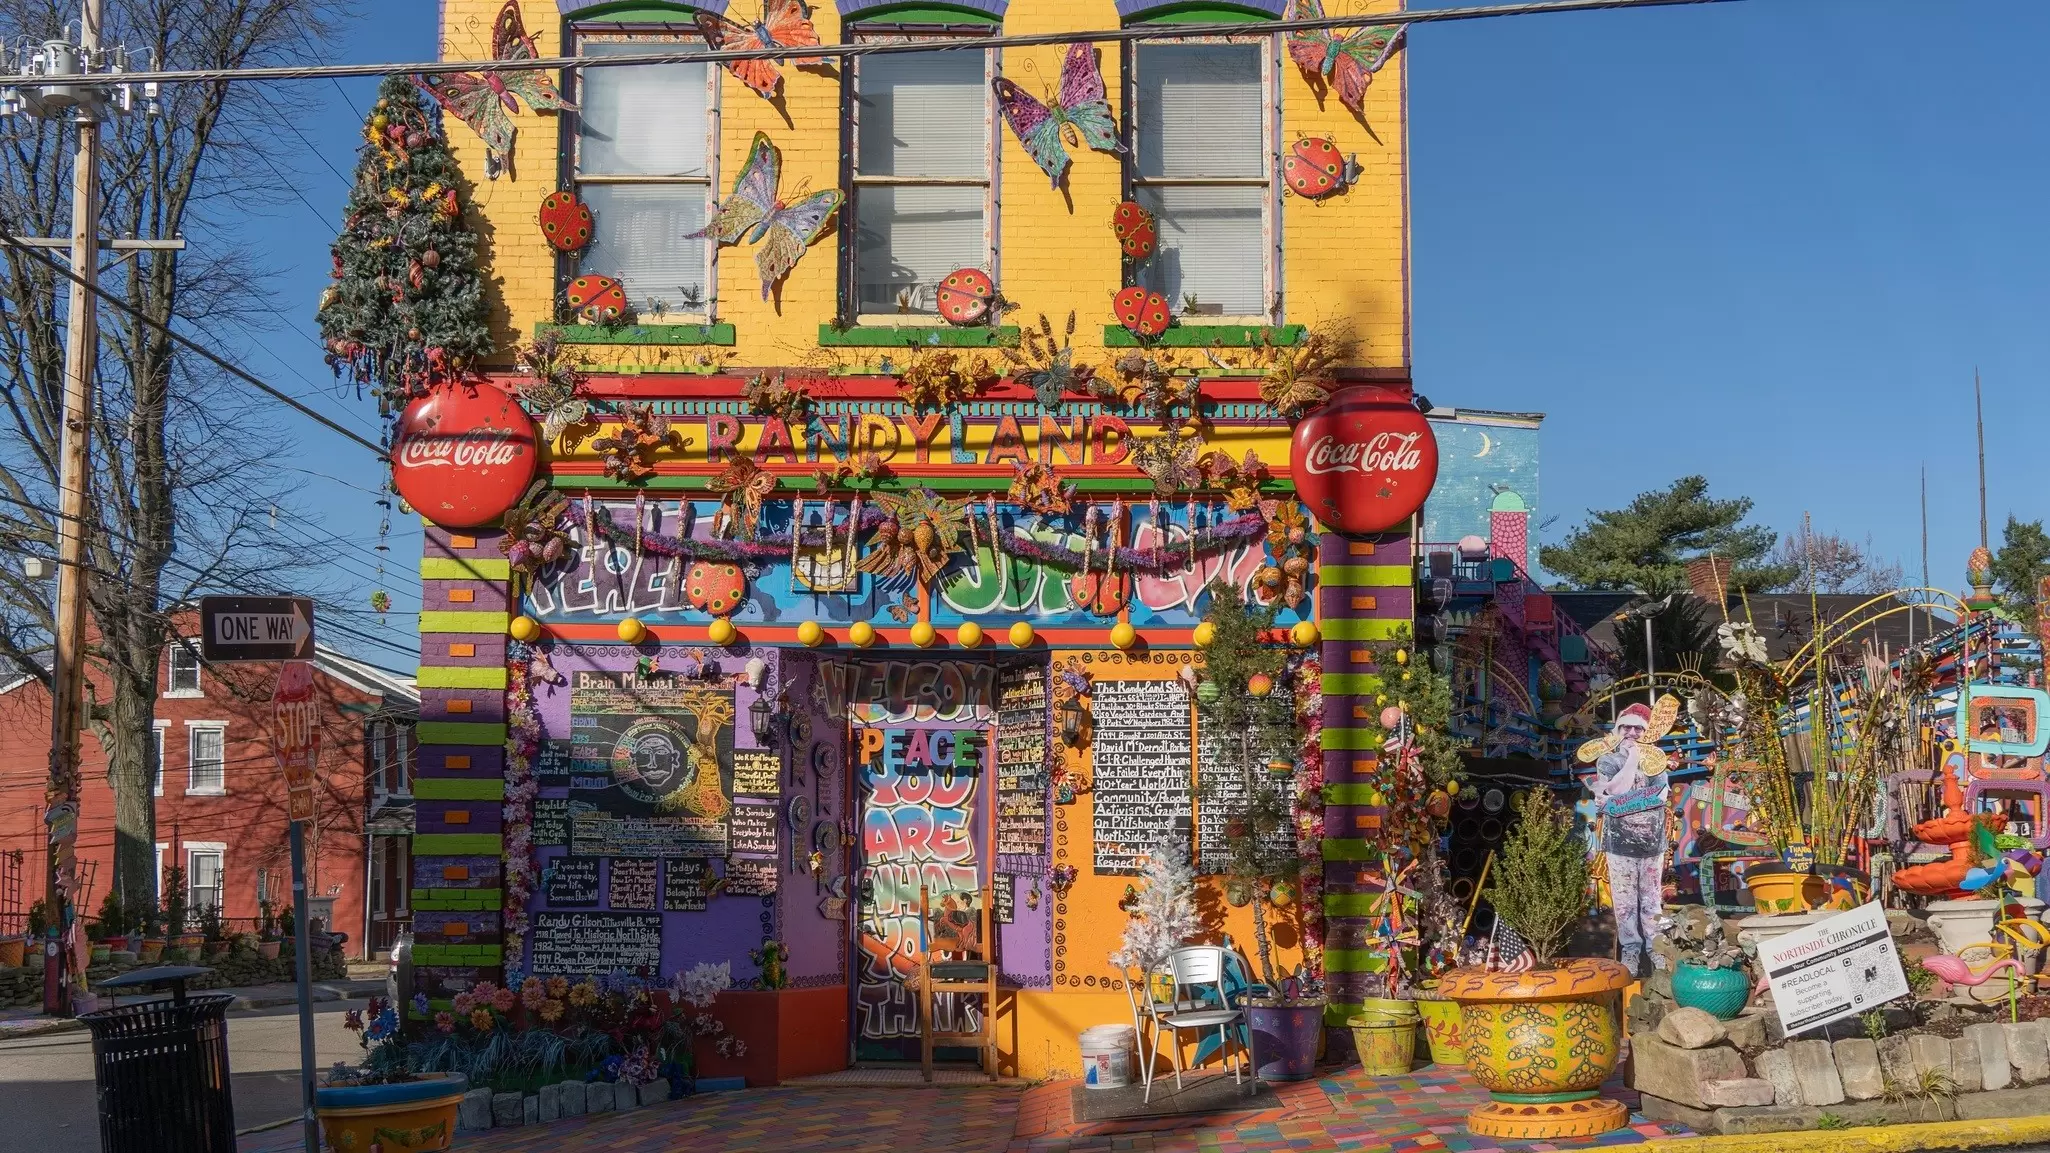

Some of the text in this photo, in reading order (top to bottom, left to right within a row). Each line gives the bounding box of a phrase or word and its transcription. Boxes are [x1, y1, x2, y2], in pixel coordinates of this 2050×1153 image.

[706, 413, 1132, 466] RANDYLAND
[1305, 431, 1424, 475] Coca-Cola
[221, 616, 294, 641] ONE WAY
[579, 672, 616, 690] Brain
[1095, 682, 1115, 693] The
[818, 658, 1009, 726] WELCOM
[1138, 710, 1167, 718] Gardens
[275, 701, 317, 749] STOP
[860, 728, 978, 767] PEACE
[1101, 741, 1124, 752] David
[1097, 766, 1115, 777] We
[1117, 766, 1139, 777] Failed
[735, 807, 744, 816] Be
[732, 818, 746, 826] Who
[1094, 819, 1109, 827] On
[1201, 815, 1212, 823] Do
[762, 828, 775, 837] Feel
[865, 804, 973, 863] ARE
[1096, 843, 1137, 854] We Can
[551, 860, 560, 870] If
[561, 864, 575, 874] you
[1097, 856, 1137, 867] Respect
[567, 873, 583, 882] your
[550, 883, 567, 891] your
[538, 914, 569, 930] Randy
[573, 929, 582, 938] To
[583, 928, 615, 938] Historic
[1817, 927, 1830, 938] THE
[1773, 918, 1878, 965] NORTHSIDE CHRONICLE
[1792, 939, 1867, 970] Your Community Newspaper
[1781, 965, 1836, 990] #READLOCAL
[1795, 982, 1822, 996] Become
[1797, 989, 1832, 1006] supporting
[858, 981, 979, 1036] THNK
[1790, 1002, 1824, 1018] subscriber
